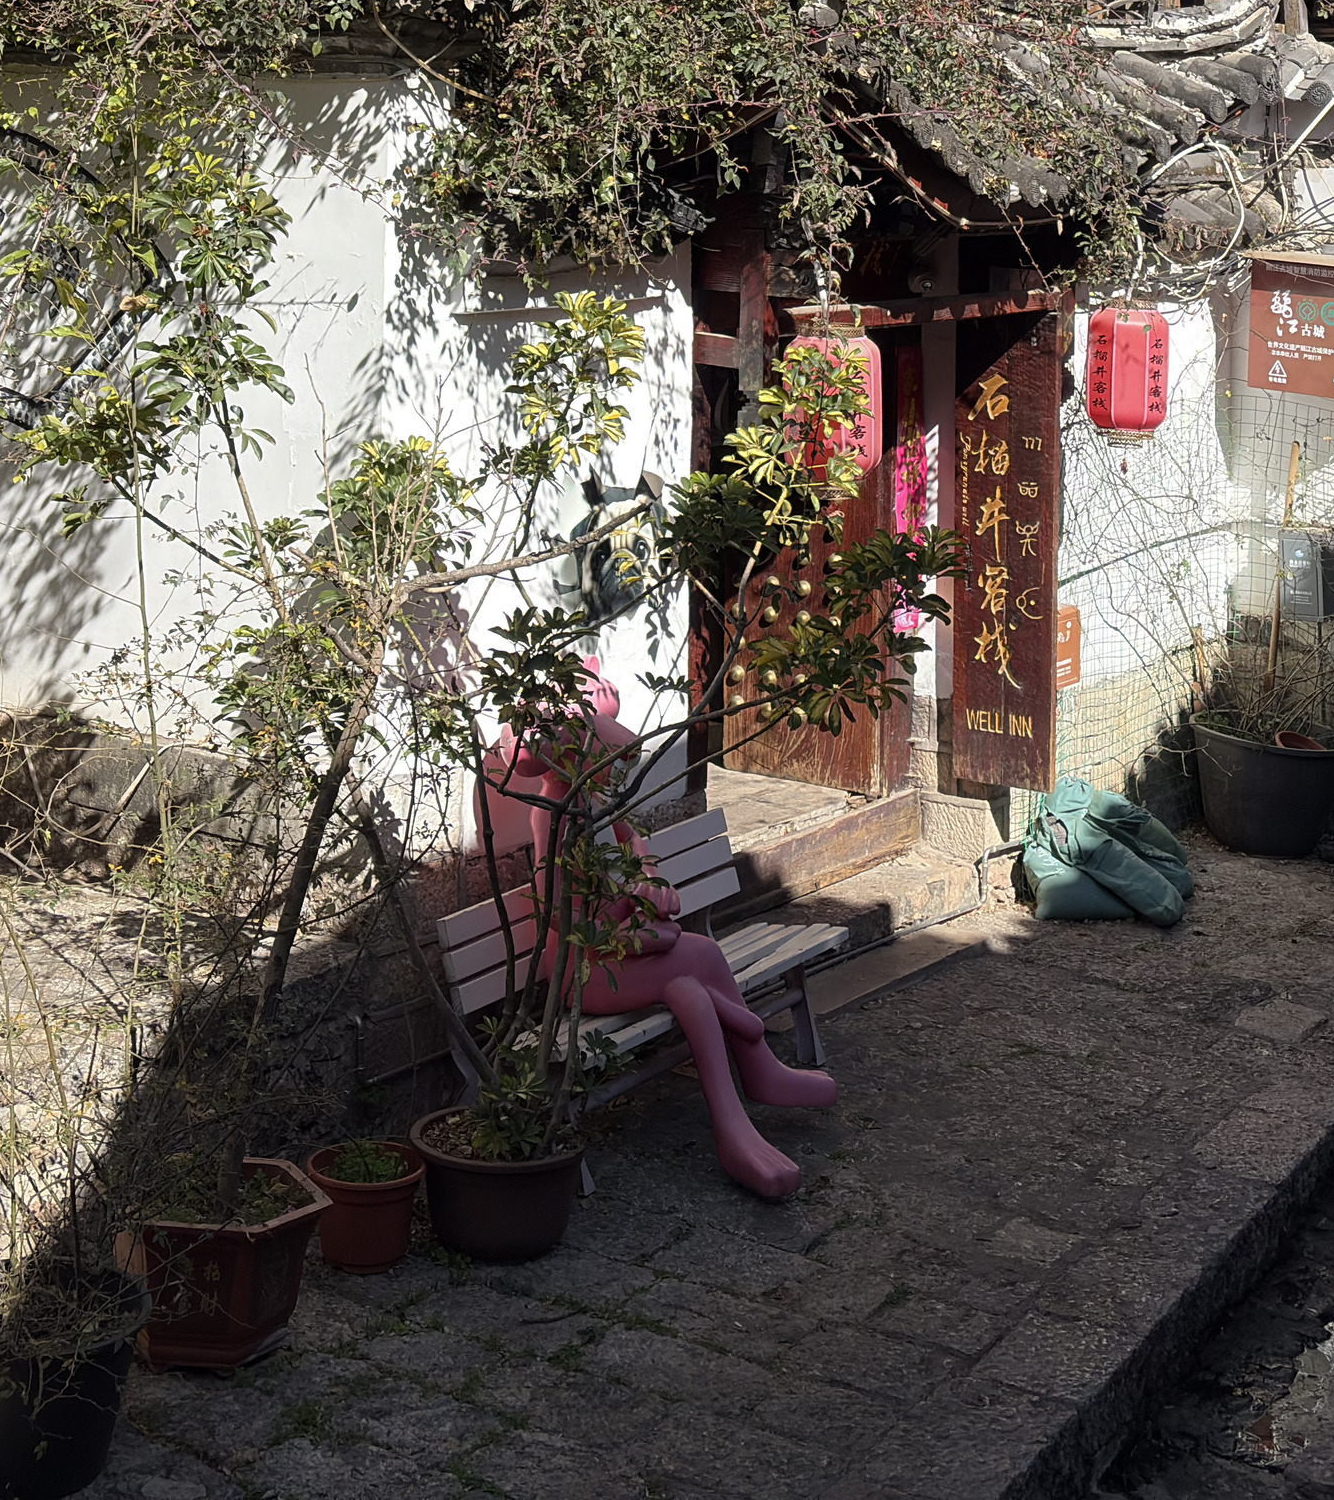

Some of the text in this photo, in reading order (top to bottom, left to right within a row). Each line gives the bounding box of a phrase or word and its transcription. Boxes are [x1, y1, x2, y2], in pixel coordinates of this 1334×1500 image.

[1092, 335, 1108, 411] 石榴井客栈
[1148, 339, 1164, 414] 石榴井客栈
[967, 372, 1021, 689] 石榴井客栈
[966, 708, 1033, 739] WELL INN
